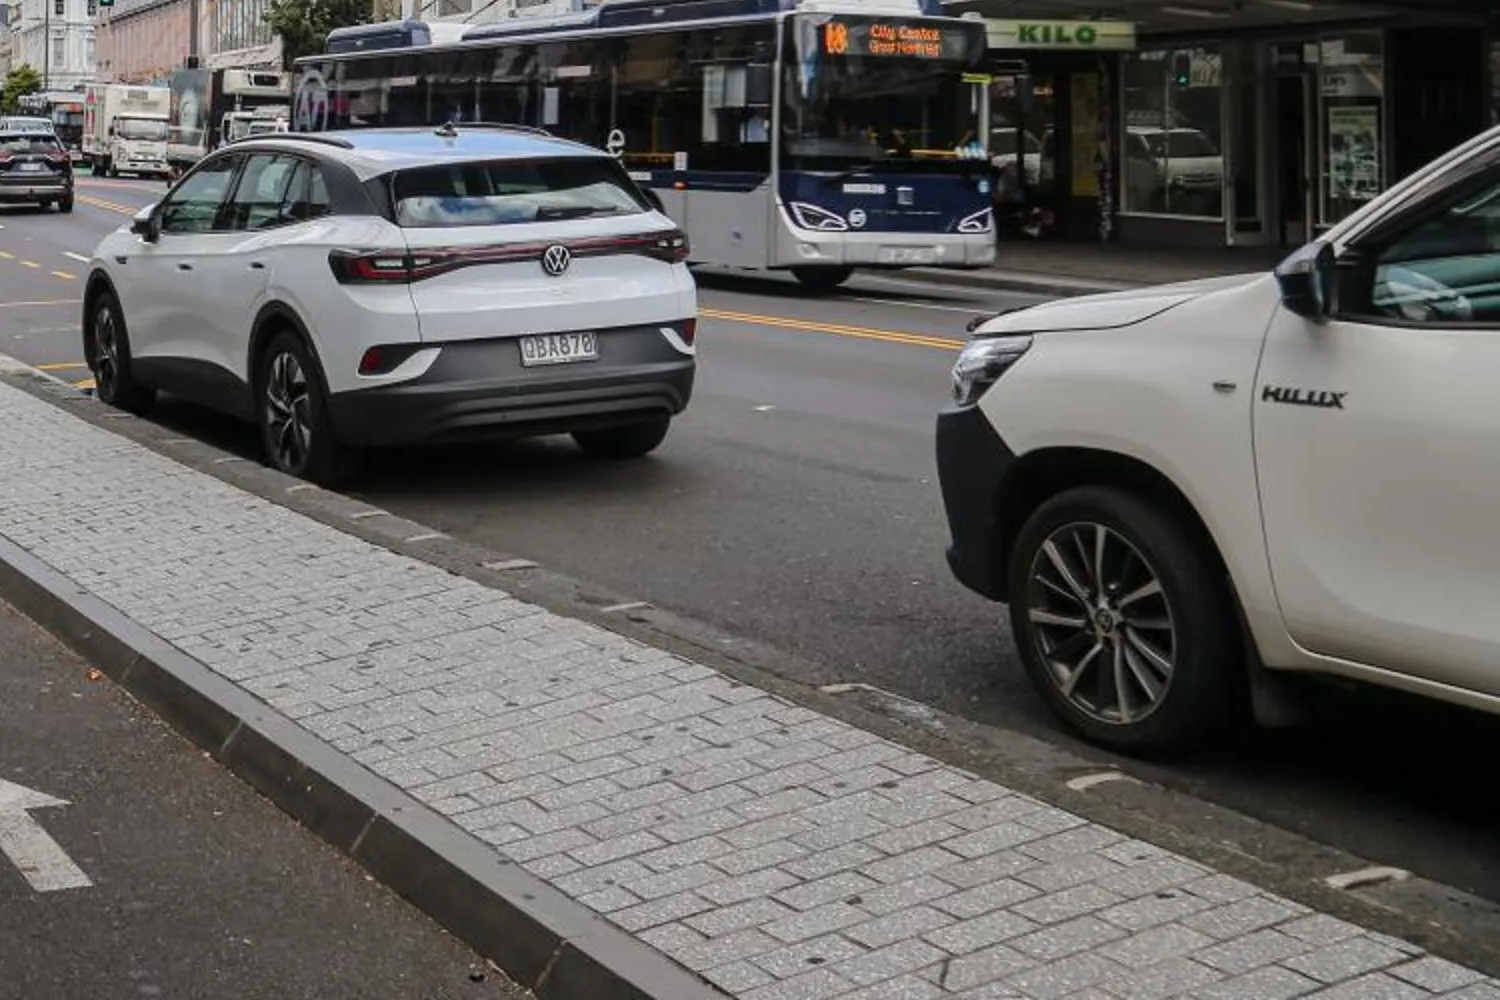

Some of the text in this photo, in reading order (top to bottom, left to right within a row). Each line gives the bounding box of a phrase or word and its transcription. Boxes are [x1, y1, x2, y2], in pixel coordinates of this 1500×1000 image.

[869, 23, 940, 41] City Centre
[1017, 23, 1097, 45] KILO
[1261, 385, 1349, 409] HILUX
